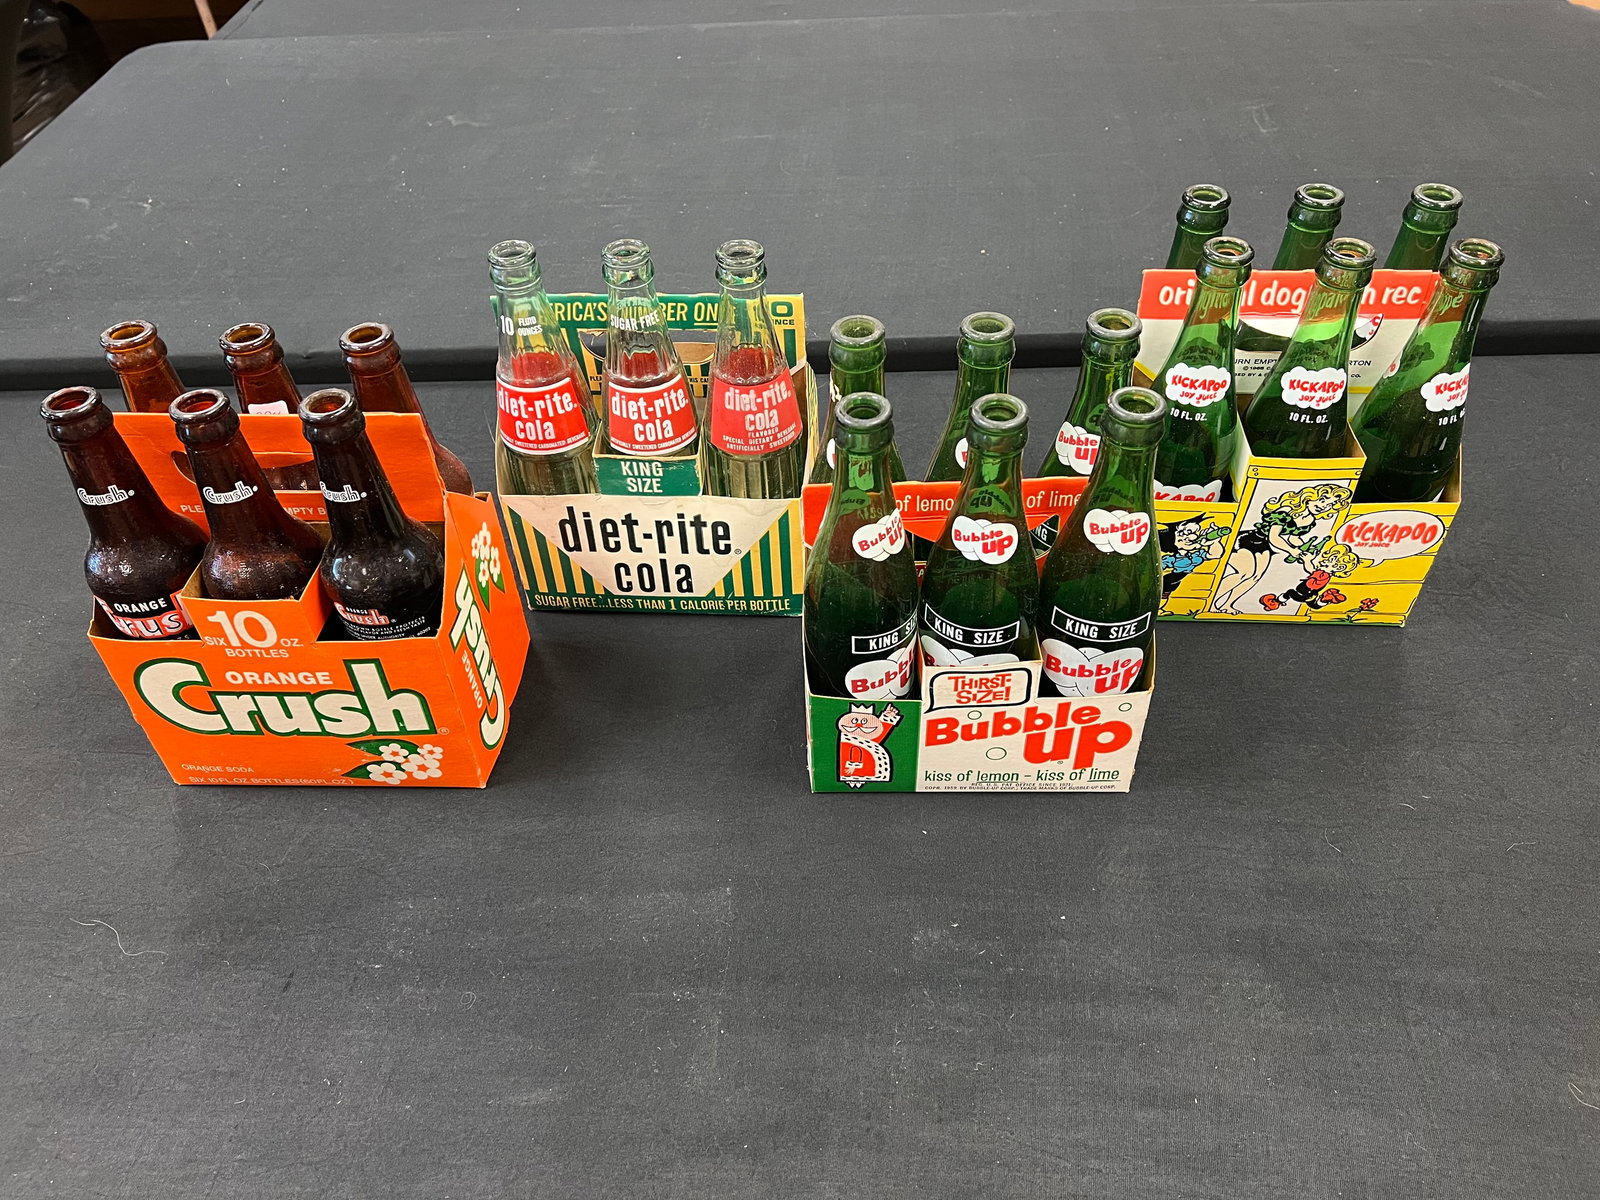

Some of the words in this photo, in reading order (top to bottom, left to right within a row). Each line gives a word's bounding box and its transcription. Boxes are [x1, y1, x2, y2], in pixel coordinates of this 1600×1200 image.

[550, 302, 608, 321] RICA'S
[693, 303, 719, 322] ON
[610, 314, 638, 331] SUGAR
[639, 310, 660, 329] FREE
[500, 315, 514, 336] 10
[518, 316, 537, 327] FLUID
[517, 325, 543, 337] OUNCES
[1171, 375, 1227, 392] KICKAPOO
[1289, 379, 1345, 394] KICKAPOO
[1435, 374, 1469, 395] KICKA
[1180, 391, 1196, 399] JOY
[1196, 392, 1217, 401] JUICE
[1299, 394, 1315, 402] JOY
[1316, 393, 1336, 403] JUICE
[744, 408, 779, 431] cola
[1170, 407, 1180, 417] 10
[1181, 410, 1193, 421] FL.
[1195, 412, 1207, 421] OZ.
[1289, 411, 1300, 422] 10
[1300, 414, 1314, 423] FL.
[1316, 414, 1329, 423] OZ.
[1438, 416, 1449, 426] 10
[515, 420, 556, 440] cola
[633, 419, 674, 442] cola
[747, 427, 779, 438] FLAVORED
[1058, 430, 1098, 447] Bubble
[722, 435, 744, 444] SPECIAL
[748, 435, 773, 445] DIETARY
[726, 443, 764, 451] ARTIFICIALLY
[620, 461, 664, 477] KING
[627, 478, 664, 493] SIZE
[180, 504, 204, 513] PLE
[285, 507, 314, 515] MPTY
[916, 495, 955, 512] lemo
[1026, 490, 1046, 508] of
[558, 505, 731, 556] diet-rite
[858, 516, 898, 552] Bubble
[1089, 518, 1142, 535] Bubble
[1341, 521, 1438, 544] KICKAPOO
[954, 529, 1003, 542] Bubble
[614, 558, 694, 594] cola
[113, 598, 168, 613] ORANGE
[535, 594, 571, 608] SUGAR
[635, 599, 666, 610] THAN
[669, 599, 677, 611] 1
[680, 599, 725, 611] CALORIE
[727, 600, 747, 611] PER
[749, 599, 791, 611] BOTTLE
[207, 610, 278, 648] 10
[934, 618, 963, 643] KING
[973, 629, 1004, 644] SIZE
[1065, 618, 1098, 639] KING
[1108, 622, 1137, 639] SIZE
[204, 635, 228, 646] SIX
[280, 638, 304, 647] OZ.
[869, 631, 899, 651] KING
[225, 648, 290, 658] BOTTLES
[449, 563, 506, 750] Crush
[850, 648, 913, 693] Bubbl
[1045, 654, 1130, 678] Bubble
[225, 671, 334, 685] ORANGE
[461, 650, 483, 709] ORANGE
[135, 659, 437, 736] Crush
[925, 702, 1102, 747] Bubble
[181, 763, 225, 773] ORANGE
[924, 770, 952, 782] kiss
[957, 769, 973, 782] of
[976, 770, 1020, 782] lemon
[1036, 769, 1065, 781] kiss
[1069, 768, 1086, 781] of
[1089, 767, 1120, 781] lime
